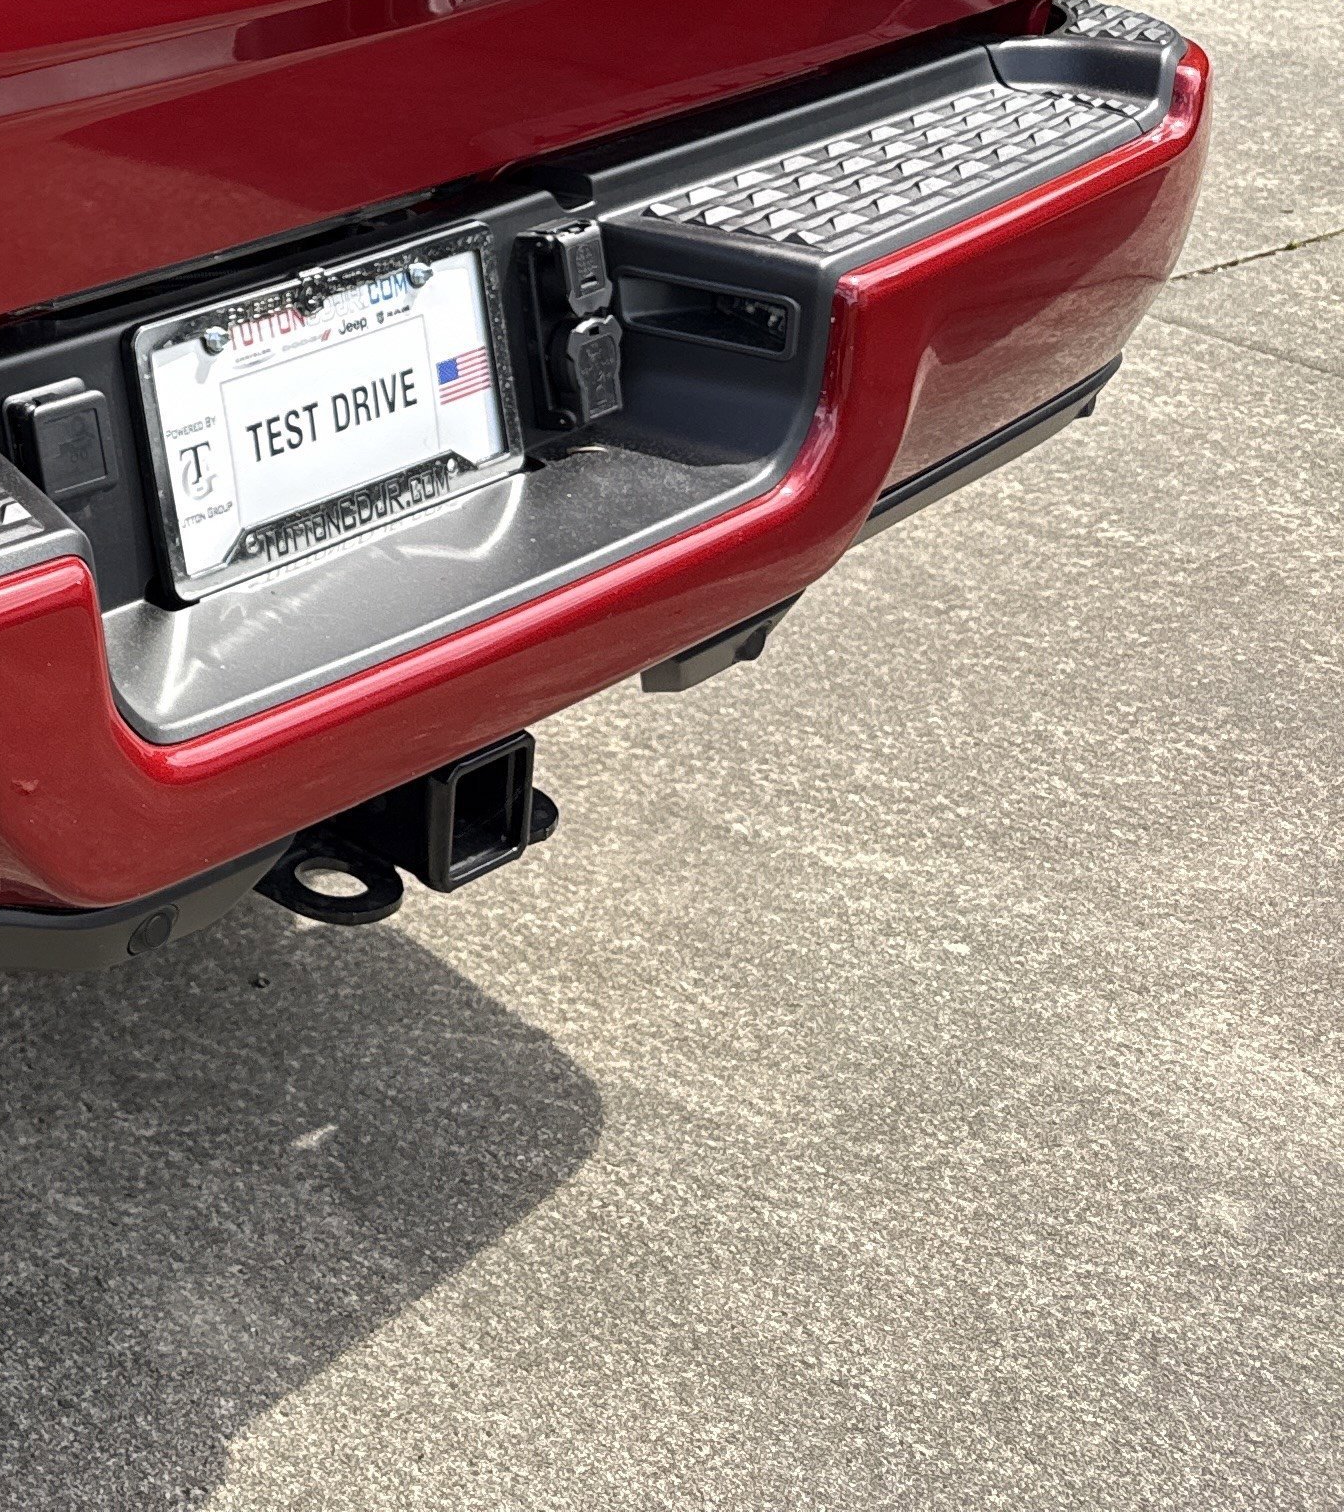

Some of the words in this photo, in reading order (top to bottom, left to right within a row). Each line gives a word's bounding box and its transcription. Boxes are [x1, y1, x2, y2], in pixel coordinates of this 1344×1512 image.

[339, 317, 368, 335] Jeep
[246, 402, 319, 463] TEST
[331, 368, 418, 434] DRIVE
[256, 464, 450, 562] TUTTONCDJR.COM
